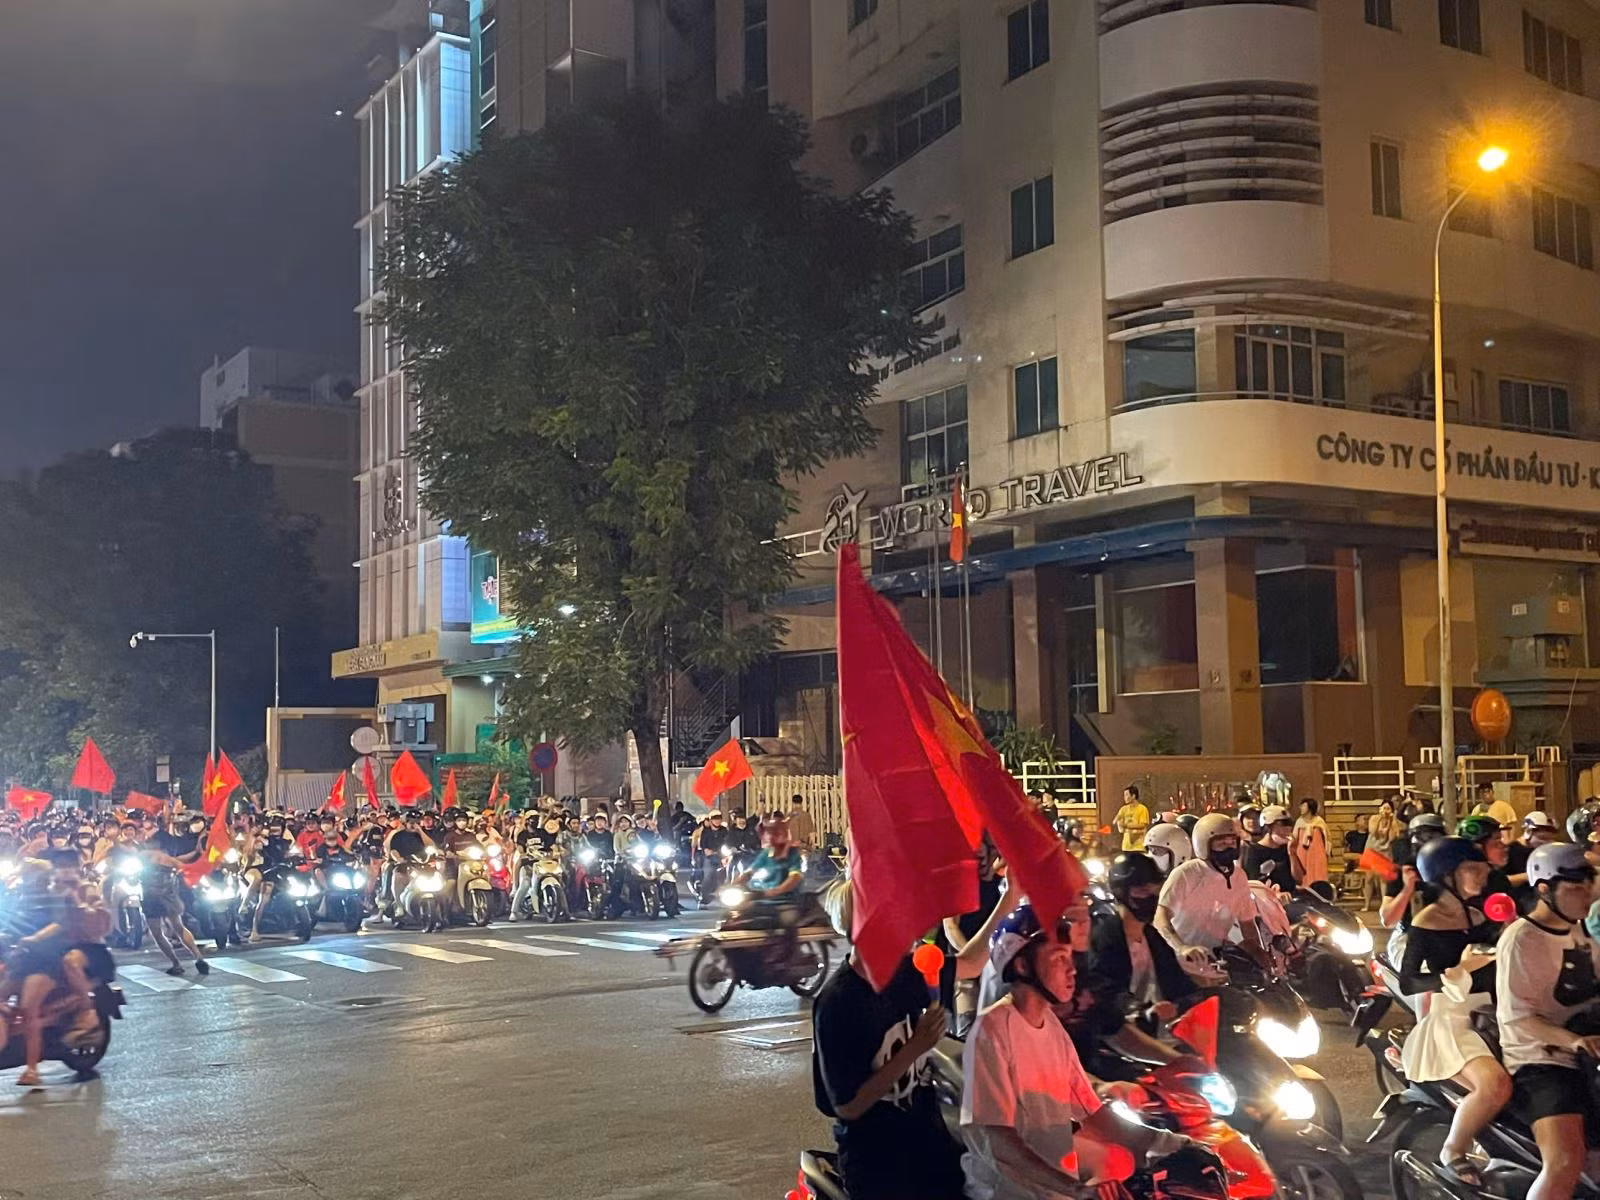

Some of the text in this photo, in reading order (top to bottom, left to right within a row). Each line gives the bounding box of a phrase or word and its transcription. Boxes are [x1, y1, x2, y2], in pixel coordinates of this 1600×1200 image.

[1316, 431, 1385, 467] CÔNG
[1390, 442, 1414, 470] TY
[1456, 445, 1510, 481] PHẦN
[1513, 451, 1552, 485] ĐẦU
[879, 452, 1143, 539] WORD TRAVEL
